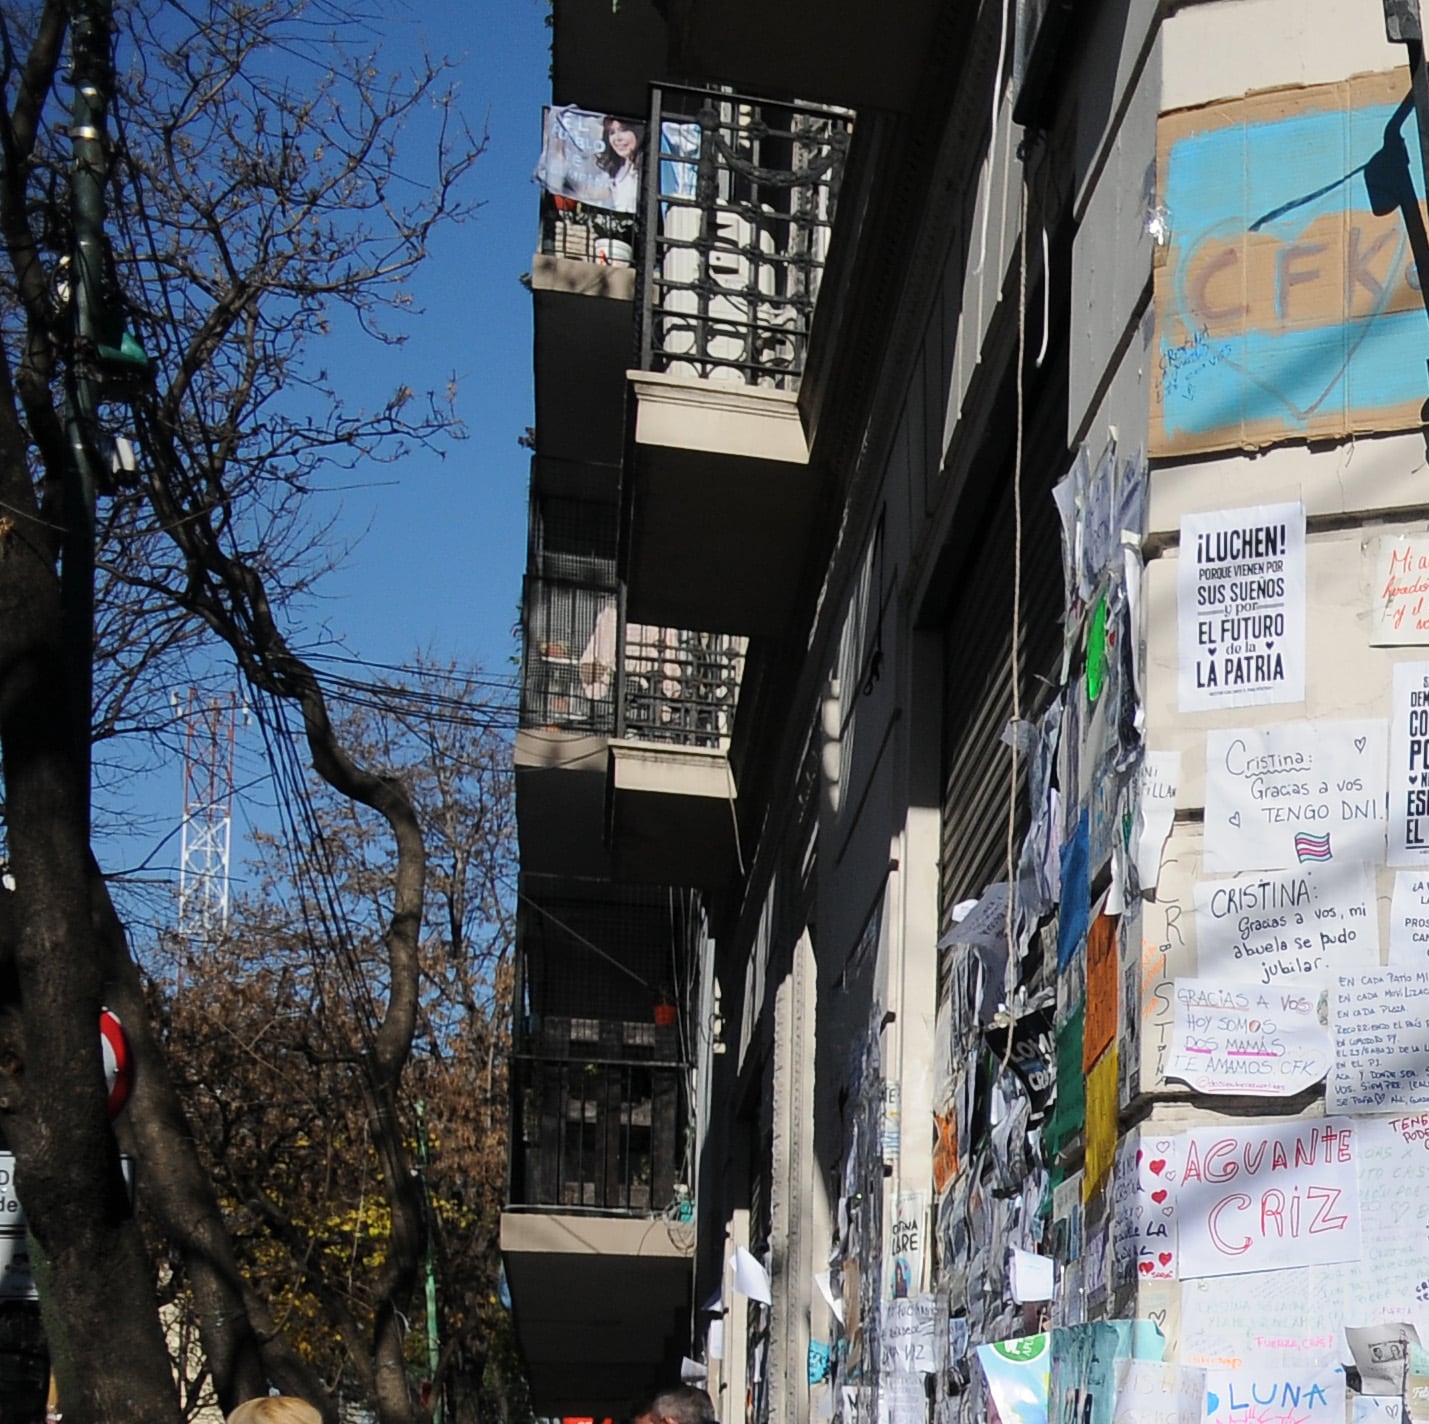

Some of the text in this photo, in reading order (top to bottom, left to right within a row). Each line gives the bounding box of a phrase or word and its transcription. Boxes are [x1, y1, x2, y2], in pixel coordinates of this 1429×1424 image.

[1196, 524, 1286, 564] ¡LUCHEN!
[1198, 560, 1284, 581] PORQUE VIENEN POR
[1197, 576, 1285, 606] SUS SUEÑOS
[1224, 601, 1259, 617] y por
[1198, 613, 1285, 645] EL FUTURO
[1225, 641, 1257, 654] de la
[1196, 652, 1285, 688] LA PATRIA
[1405, 820, 1425, 845] EL
[1412, 882, 1423, 893] ¿A
[1181, 1127, 1352, 1187] AGUANTE
